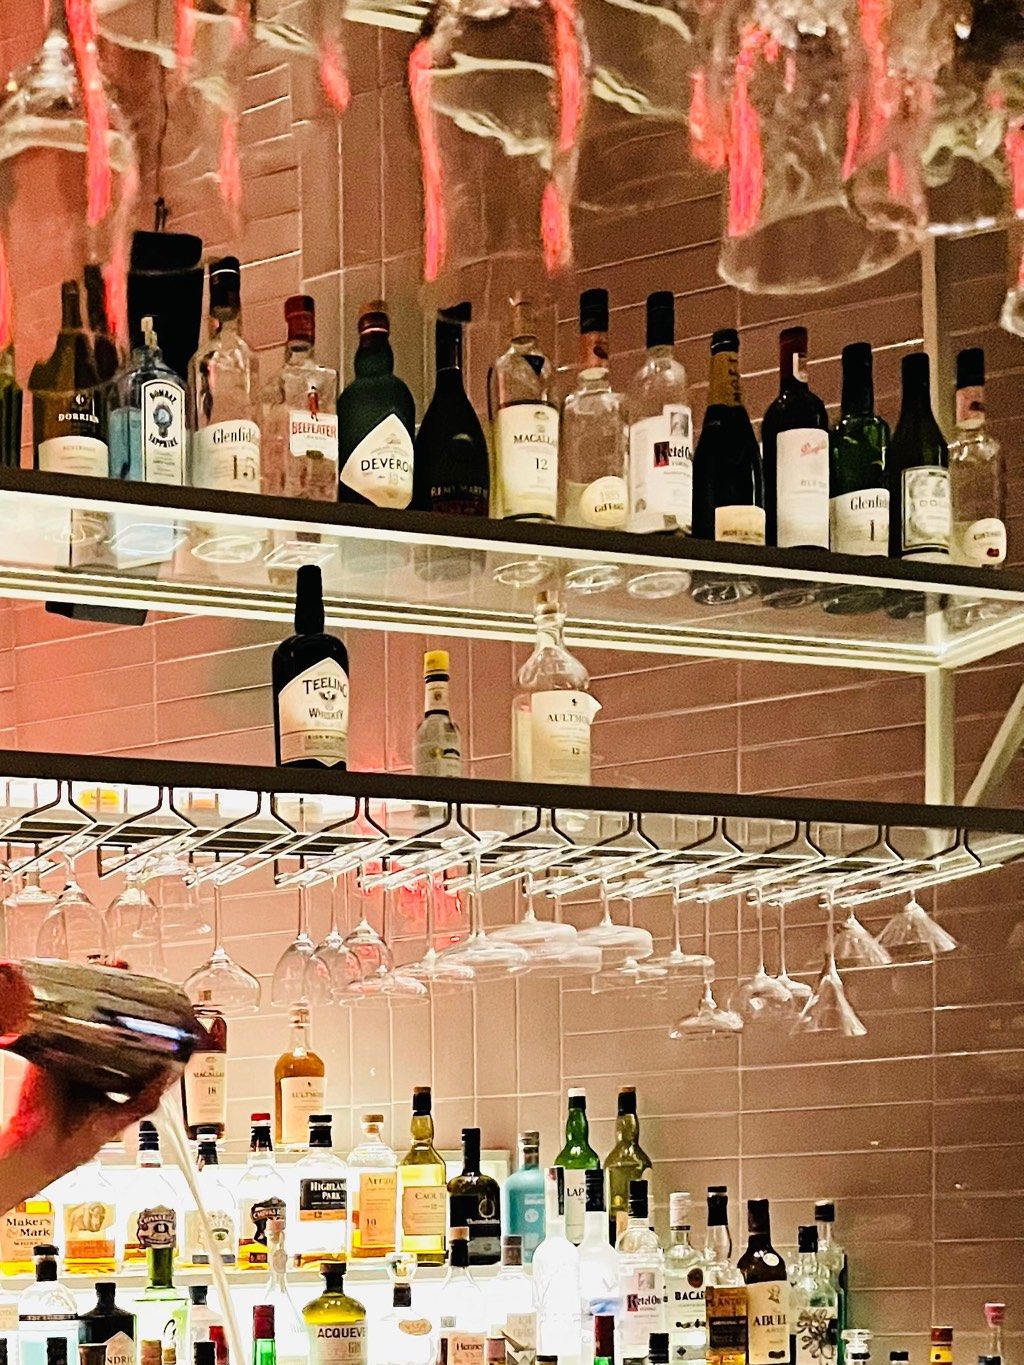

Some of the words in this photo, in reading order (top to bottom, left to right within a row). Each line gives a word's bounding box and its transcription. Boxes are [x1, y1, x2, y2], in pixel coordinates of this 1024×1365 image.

[535, 457, 549, 470] 12
[321, 1191, 342, 1200] PARK
[19, 1228, 51, 1237] Mark
[317, 1327, 366, 1339] ACQUEVE
